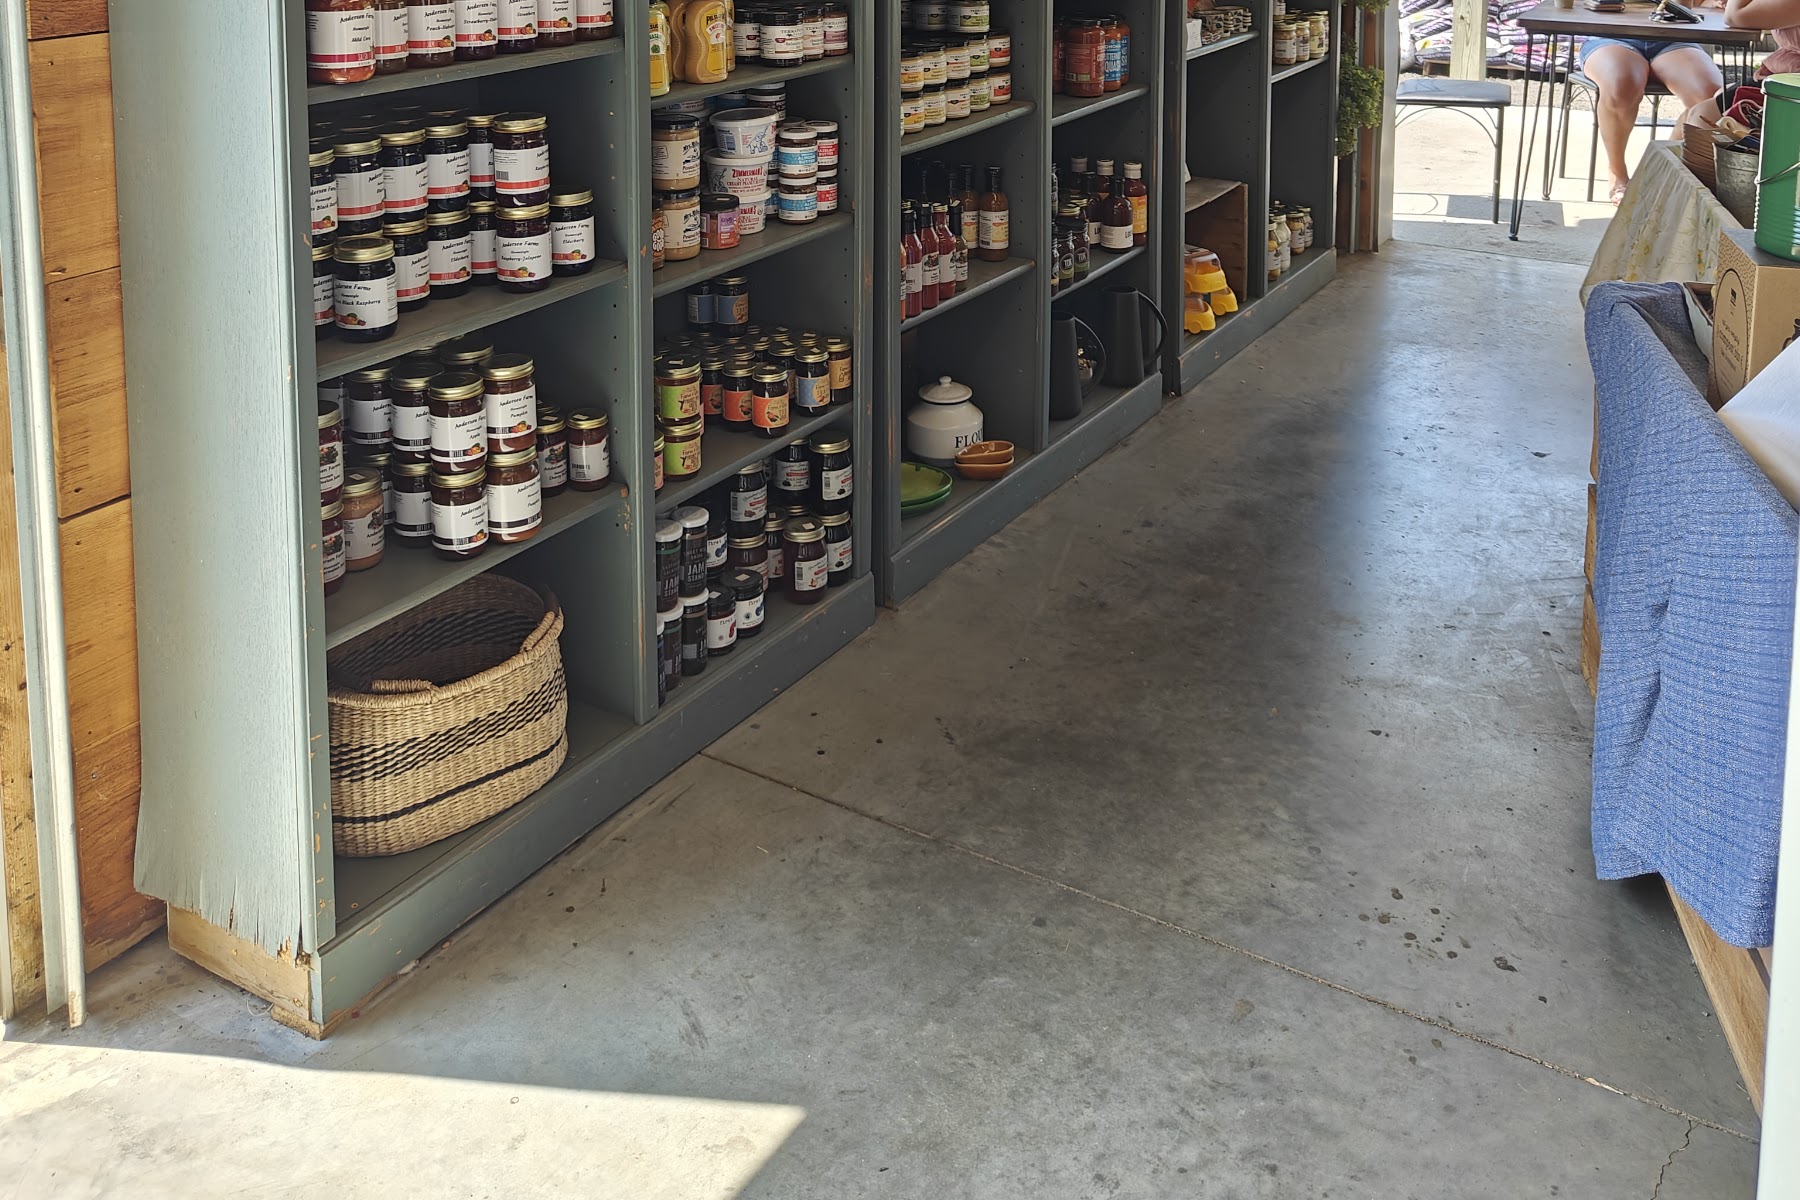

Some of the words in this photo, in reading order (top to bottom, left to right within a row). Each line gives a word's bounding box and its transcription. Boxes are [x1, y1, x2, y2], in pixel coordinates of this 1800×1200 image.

[467, 3, 488, 11] Andersen
[340, 13, 364, 23] Andersen
[424, 9, 447, 18] Andersen
[446, 154, 466, 164] Andersen
[732, 167, 763, 178] ZIMMERMAN'S
[310, 187, 327, 196] dersen
[554, 225, 577, 233] Andersen
[442, 242, 463, 251] Andersen
[353, 284, 372, 292] Farms
[356, 299, 381, 307] Raspberry
[499, 397, 522, 407] Andersen
[523, 394, 534, 402] Farm
[455, 419, 478, 429] Andersen
[470, 432, 481, 440] Apple
[955, 428, 984, 449] FLOU
[461, 505, 482, 517] Andersen
[687, 562, 705, 576] JAM
[664, 575, 679, 590] JAM
[687, 572, 705, 583] STAND
